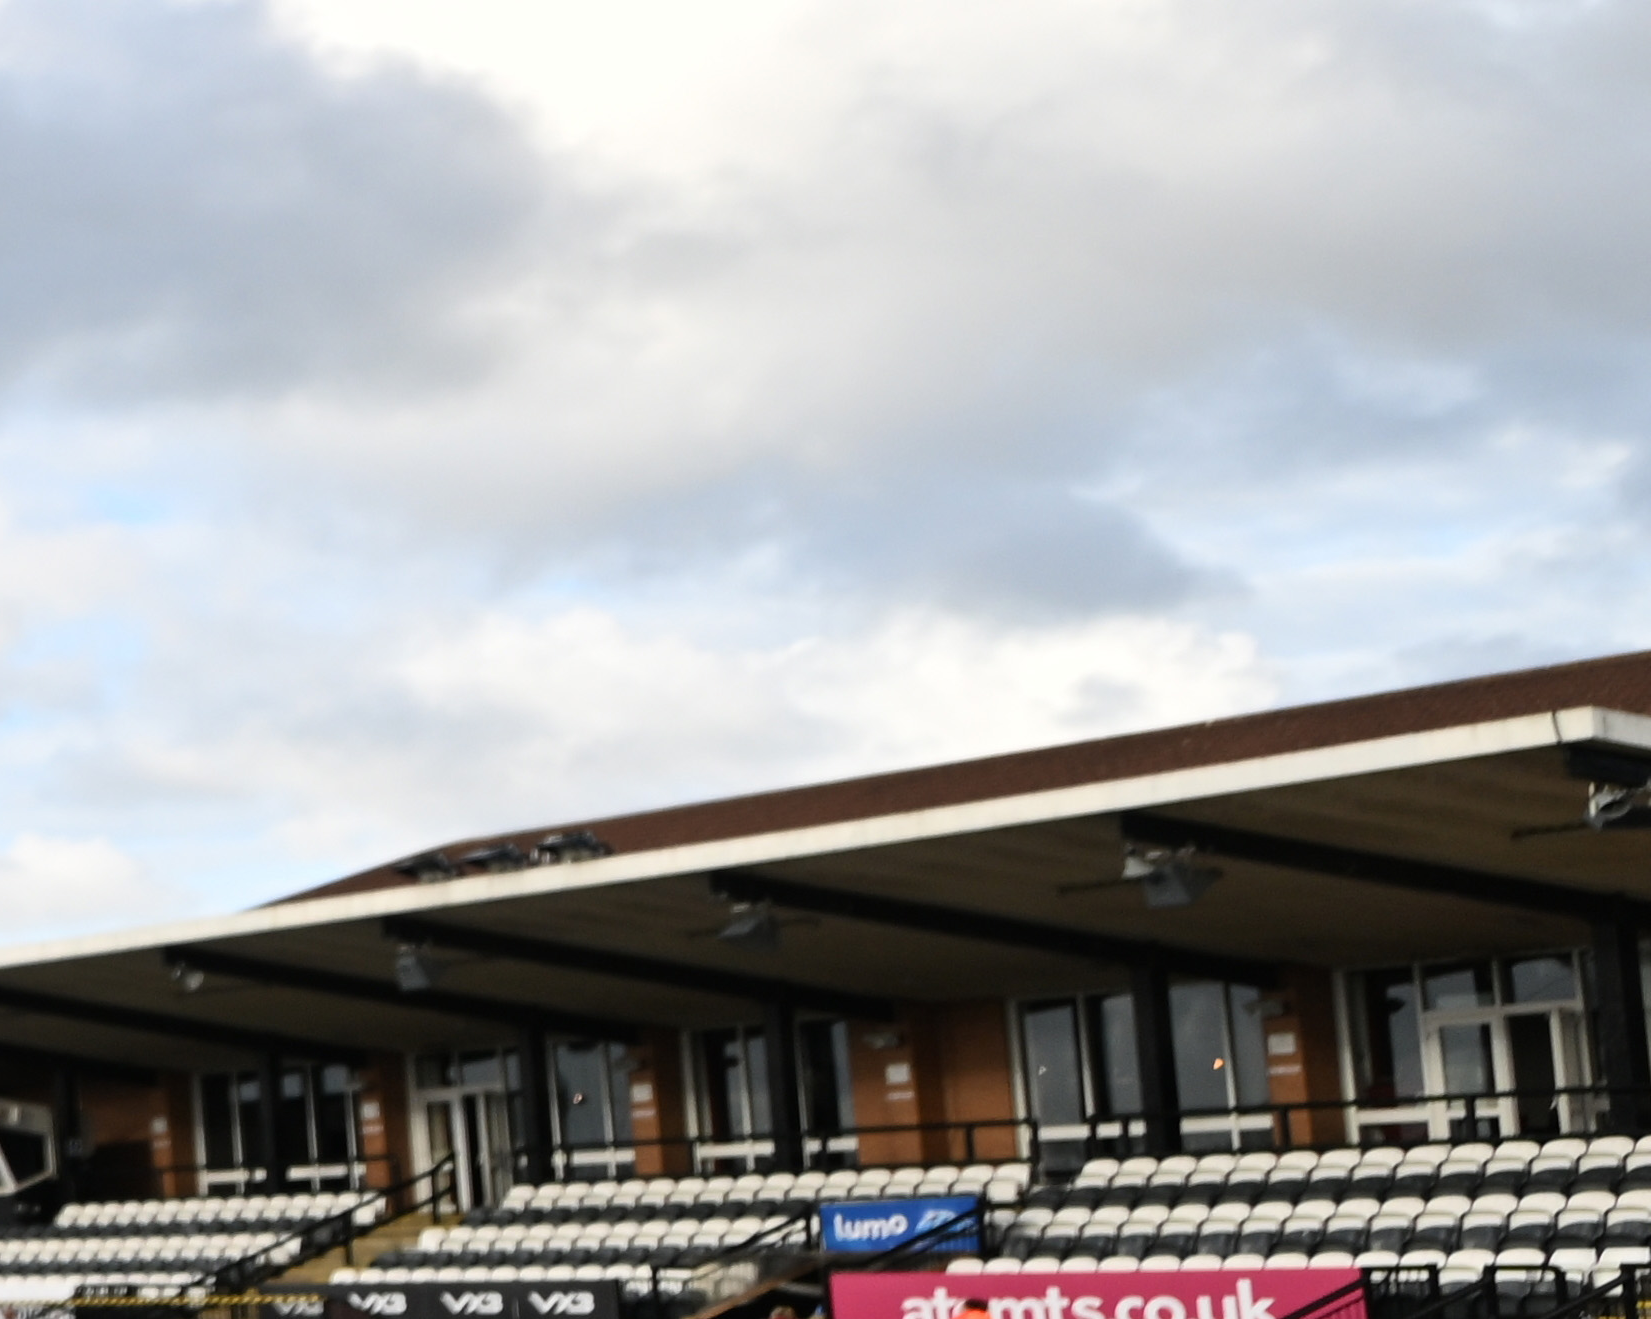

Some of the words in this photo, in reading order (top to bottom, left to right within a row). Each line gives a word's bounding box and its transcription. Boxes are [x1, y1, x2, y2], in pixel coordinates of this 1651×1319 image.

[834, 1213, 908, 1242] lumo
[441, 1291, 504, 1315] VX3
[529, 1290, 595, 1315] VX3
